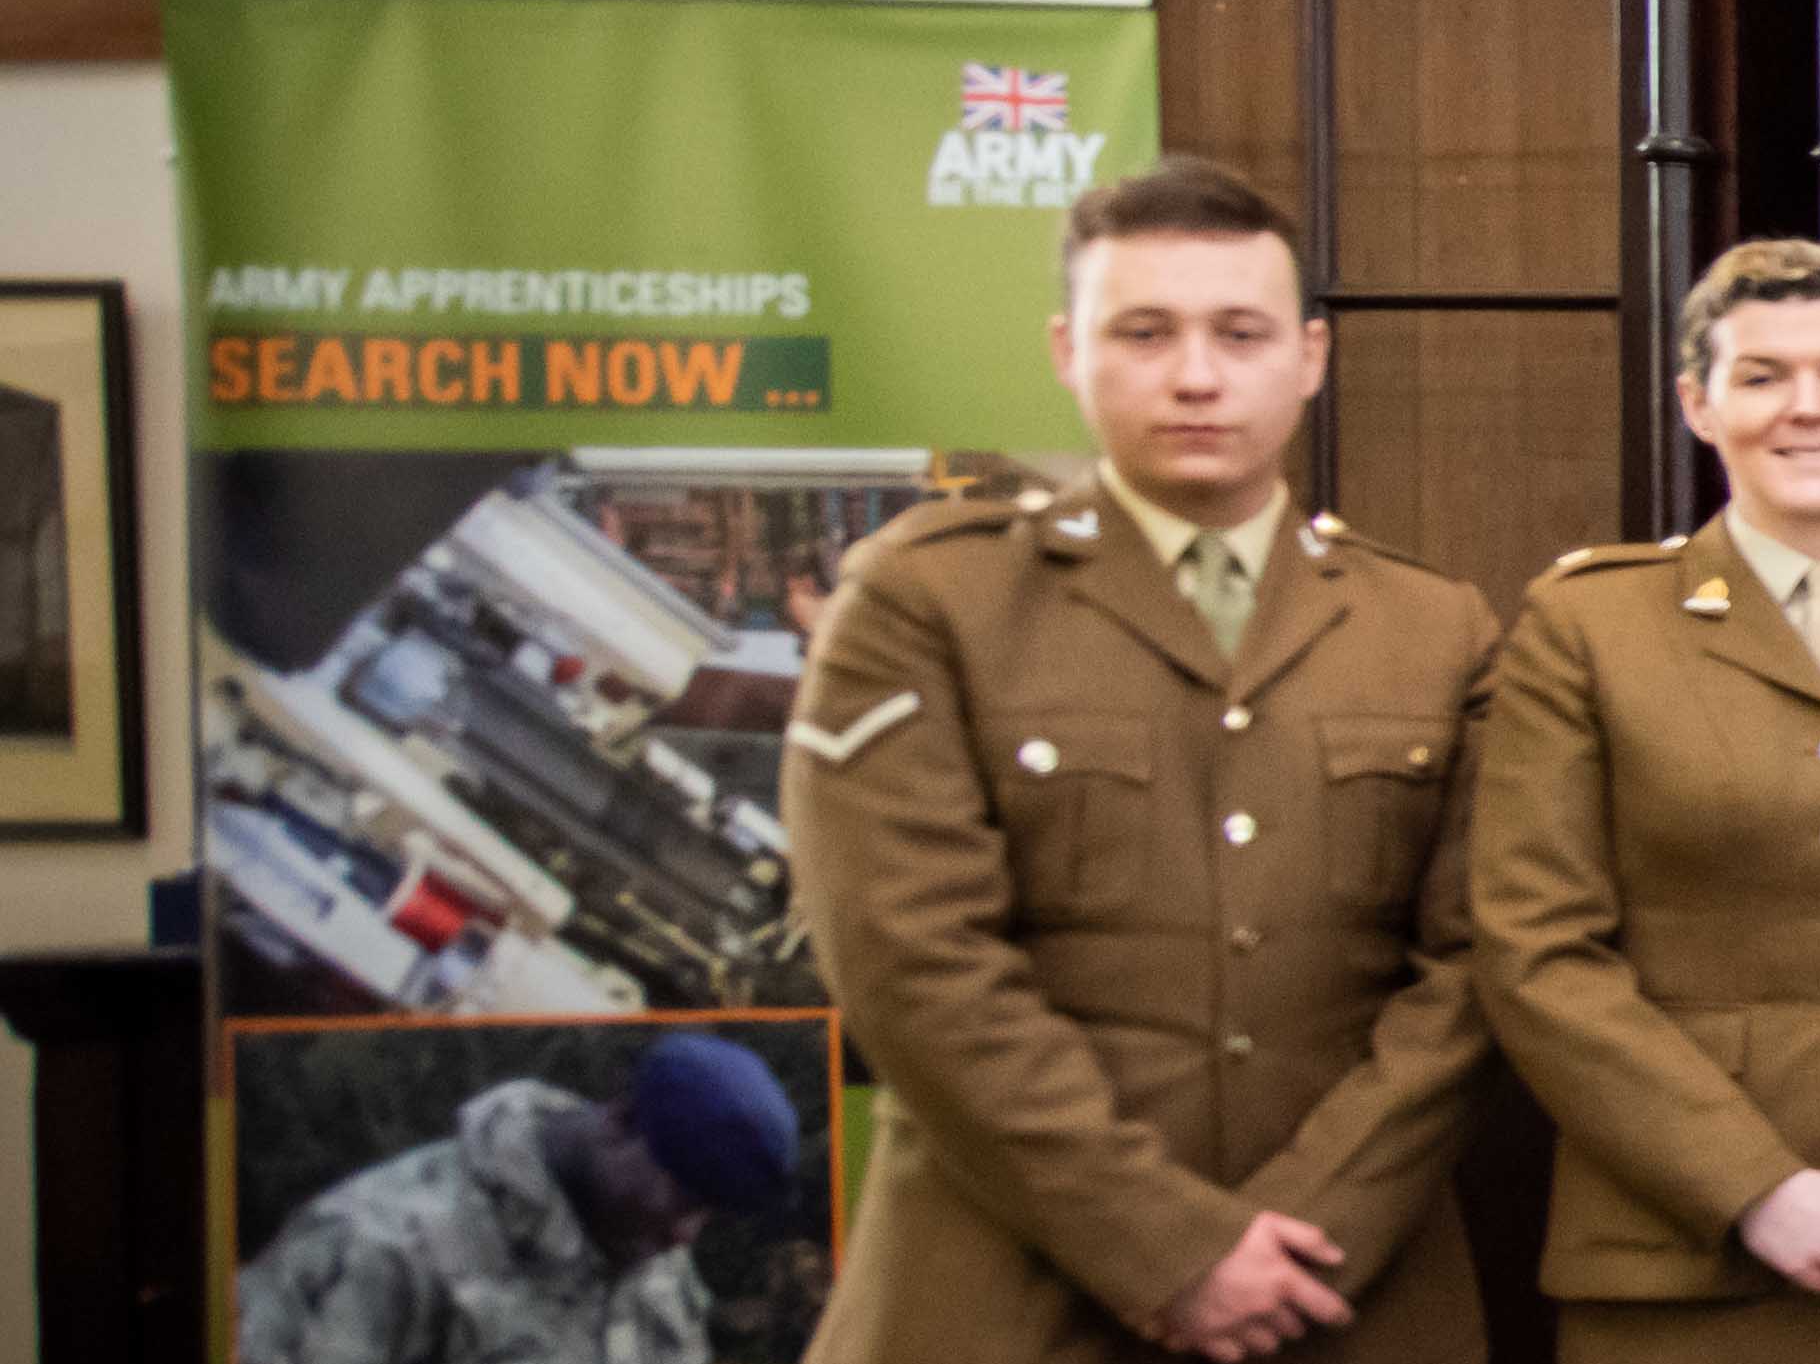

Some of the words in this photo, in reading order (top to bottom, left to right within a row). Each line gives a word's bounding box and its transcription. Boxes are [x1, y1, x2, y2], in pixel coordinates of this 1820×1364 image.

[927, 132, 1106, 183] ARMY
[210, 269, 346, 310] ARMY
[360, 271, 811, 317] APPRENTICESHIPS
[210, 339, 522, 404] SEARCH
[545, 341, 742, 405] NOW
